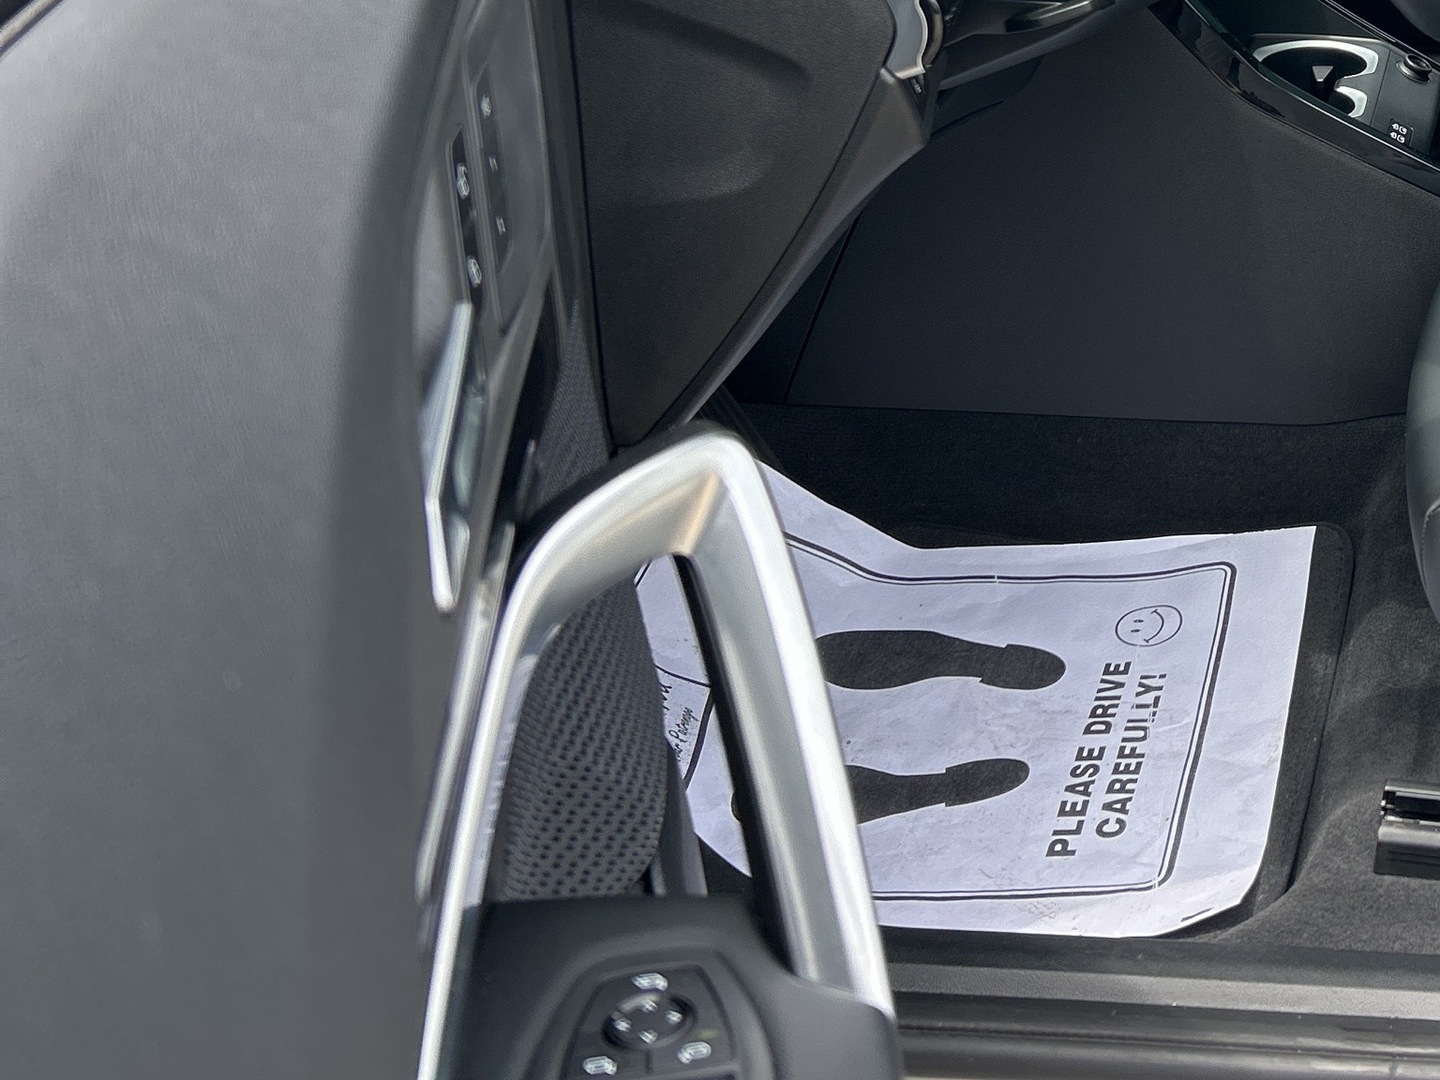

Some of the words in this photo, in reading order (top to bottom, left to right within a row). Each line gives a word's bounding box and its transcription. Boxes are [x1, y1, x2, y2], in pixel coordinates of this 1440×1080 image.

[1045, 745, 1107, 858] PLEASE
[1082, 660, 1132, 735] DRIVE
[1095, 672, 1168, 839] CAREFULLY!
